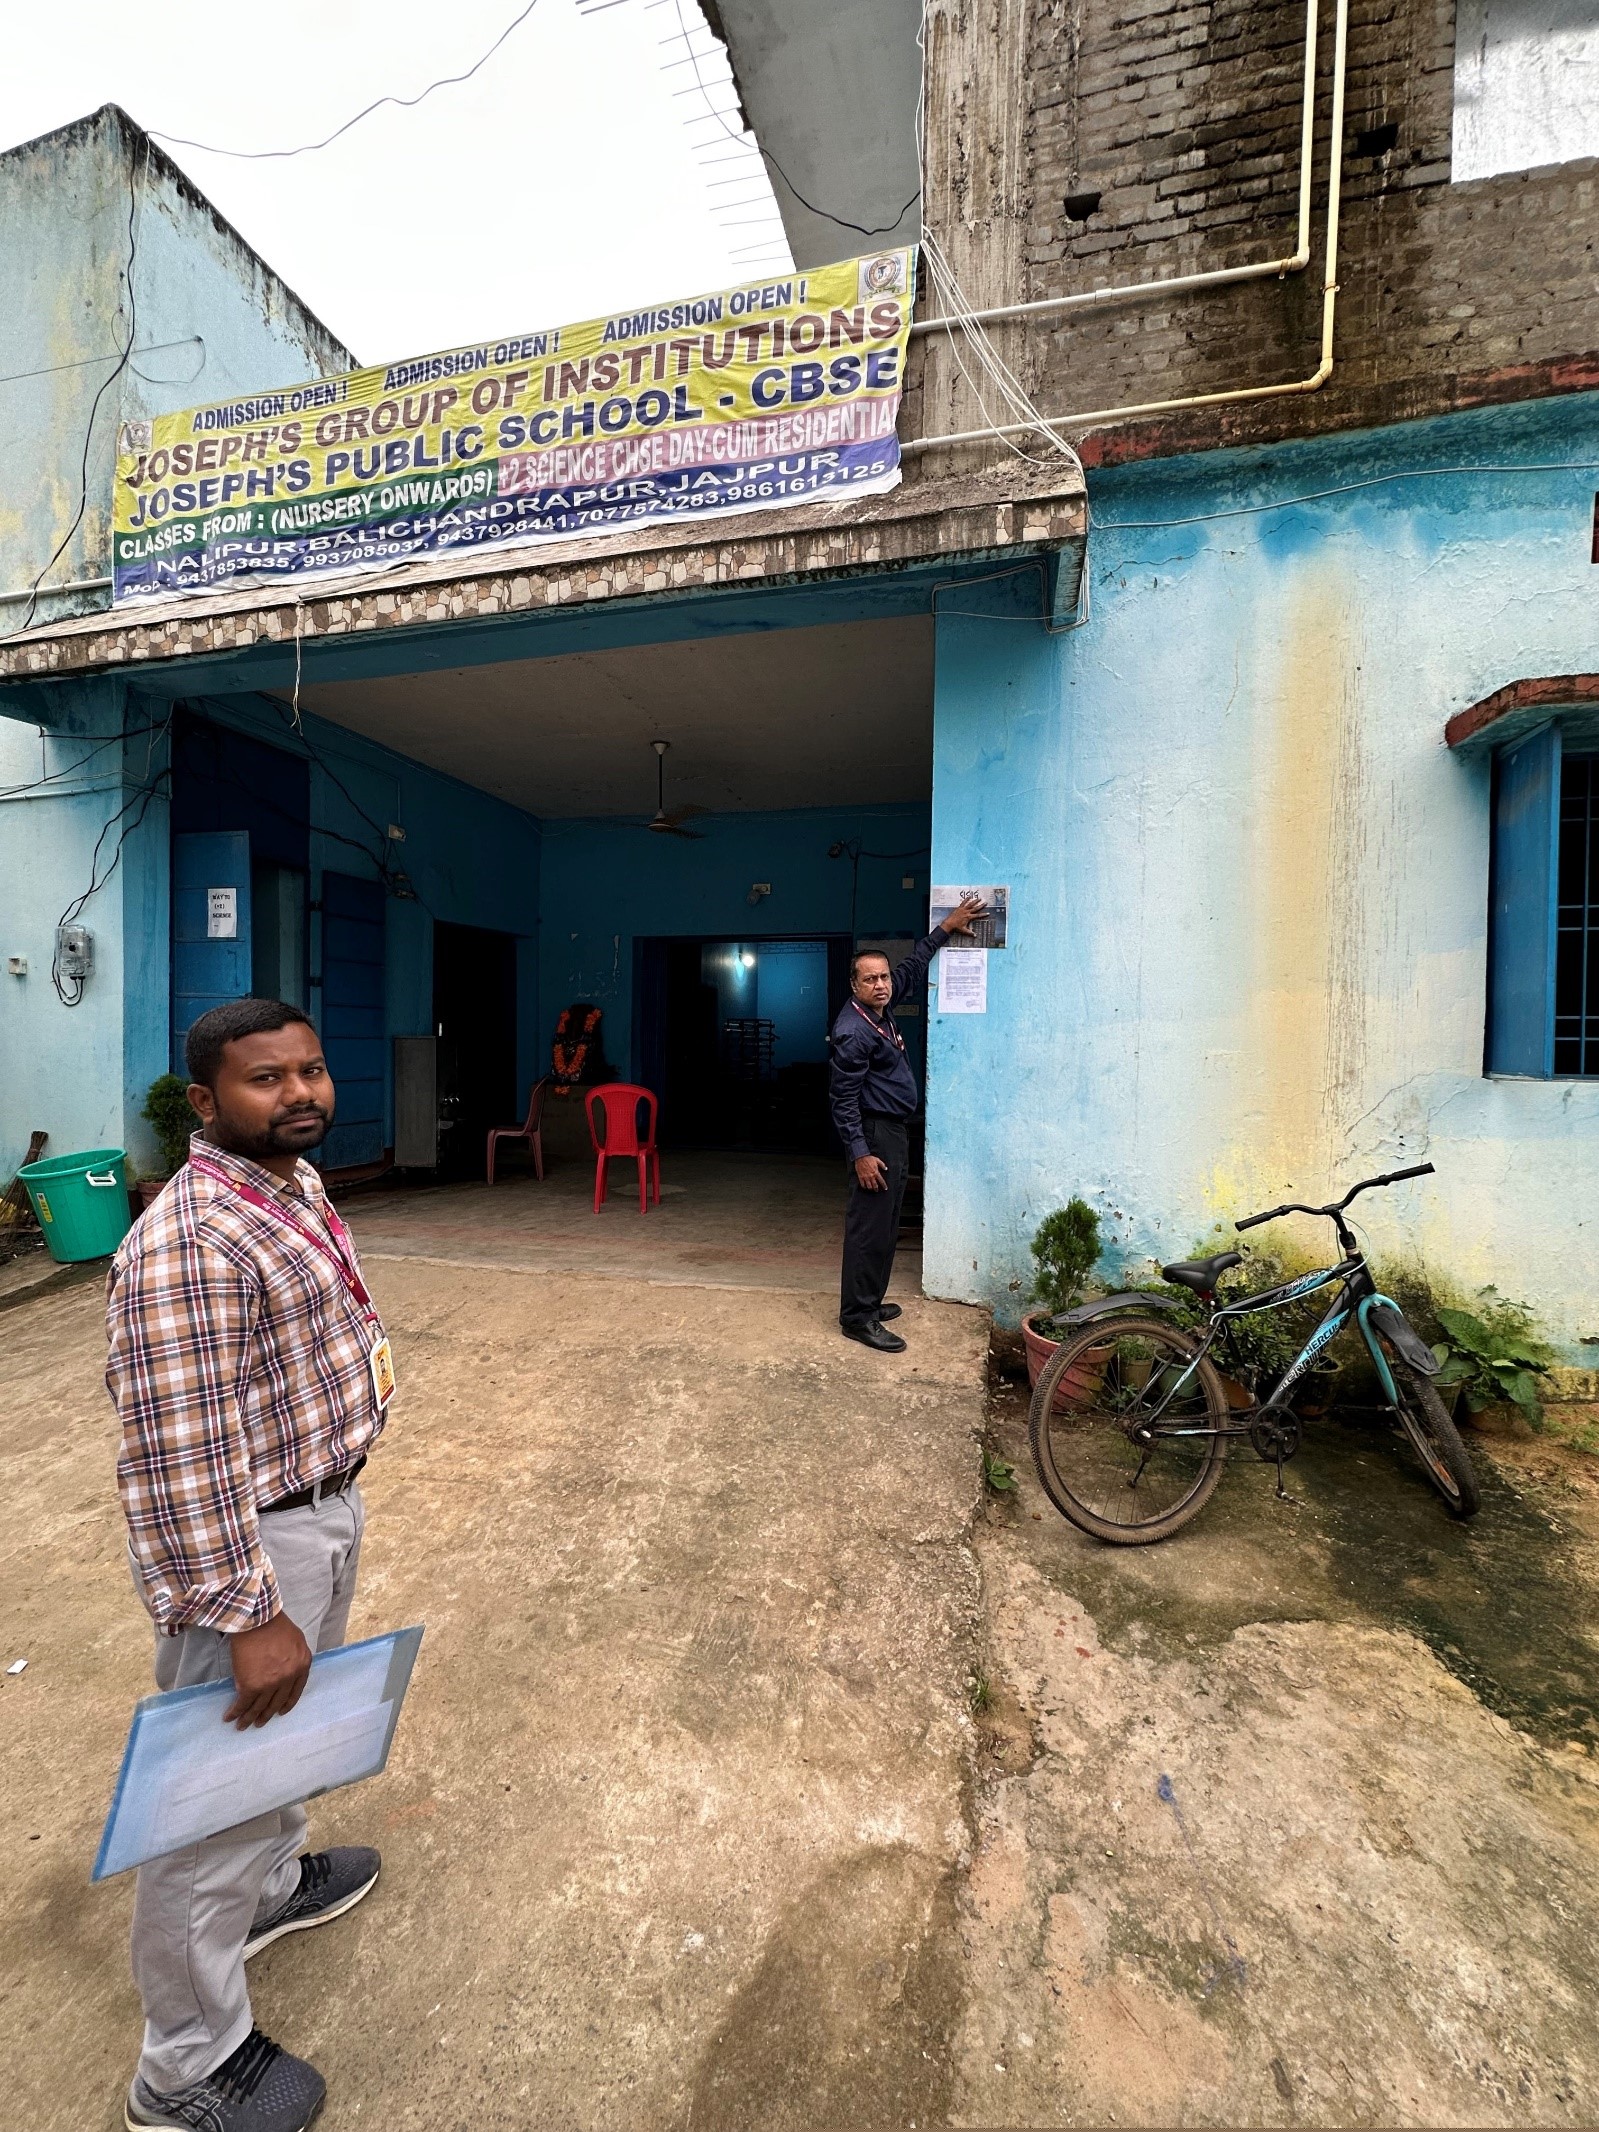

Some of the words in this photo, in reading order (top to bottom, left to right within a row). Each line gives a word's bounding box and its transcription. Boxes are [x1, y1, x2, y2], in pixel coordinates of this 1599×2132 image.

[126, 422, 301, 488] JOSEPH'S
[315, 387, 458, 447] GROUP
[471, 371, 528, 415] OF
[543, 302, 901, 402] INSTITUTIONS
[192, 395, 285, 432] ADMISSION
[290, 383, 337, 412] OPEN
[384, 349, 488, 391] ADMISSION
[494, 332, 548, 365] OPEN
[602, 297, 723, 344] ADMISSION
[730, 282, 792, 315] OPEN
[129, 460, 311, 527] JOSEPH'S
[325, 425, 483, 485] PUBLIC
[498, 385, 703, 449] SCHOOL
[751, 347, 898, 408] CBSE
[499, 457, 520, 492] +2
[525, 445, 606, 490] SCIENCE
[611, 435, 663, 475] CHSE
[669, 422, 758, 467] DAY-CUM
[119, 523, 197, 560] CLASSES
[202, 511, 251, 541] FROM
[271, 492, 375, 535] (NURSERY
[380, 468, 493, 510] ONWARDS)
